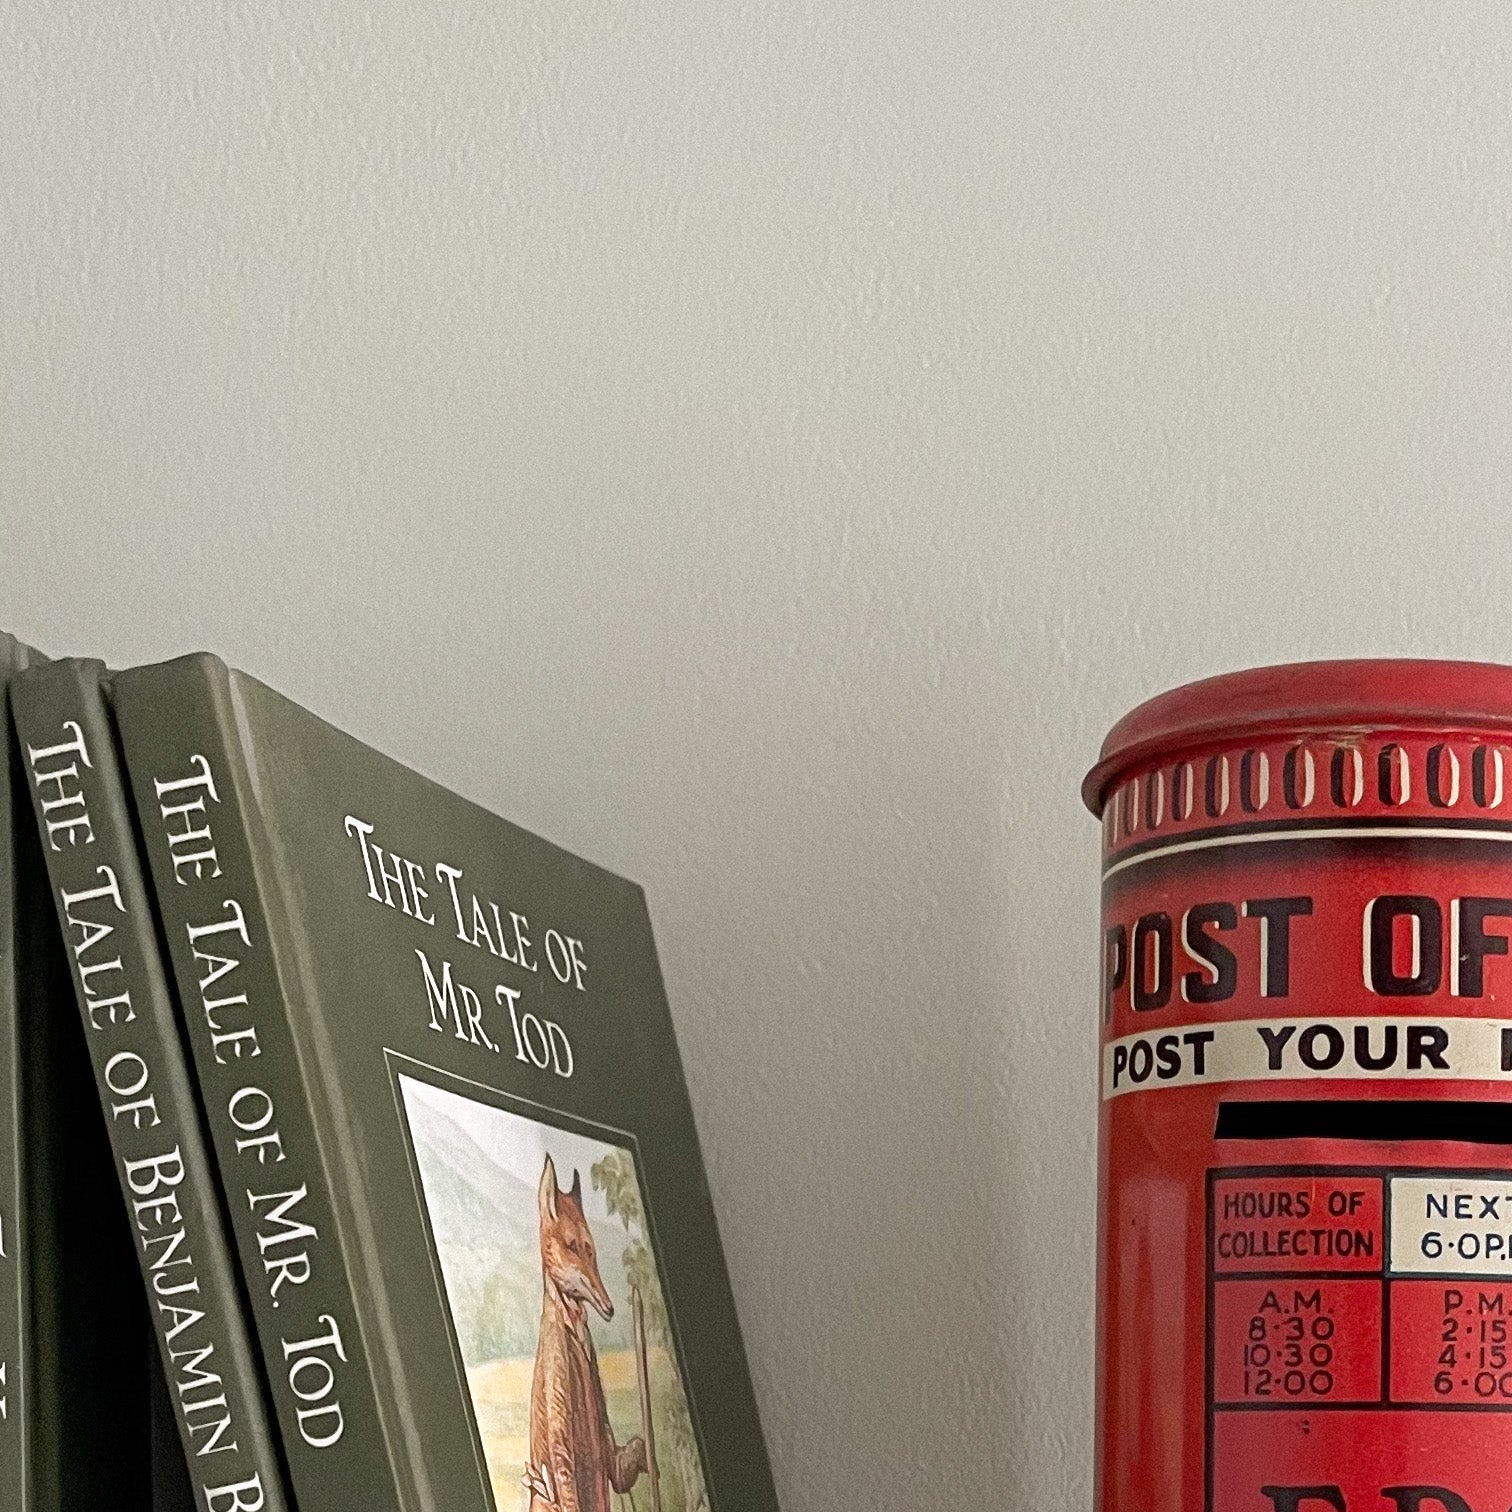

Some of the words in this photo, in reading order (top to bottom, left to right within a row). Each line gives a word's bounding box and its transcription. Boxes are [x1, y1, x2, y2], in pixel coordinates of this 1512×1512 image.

[27, 720, 95, 852] THE
[153, 754, 223, 886] THE
[61, 865, 137, 1031] TALE
[344, 814, 435, 926] THE
[435, 862, 538, 972] TALE
[544, 928, 588, 992] OF
[1103, 896, 1313, 1026] POST
[186, 899, 262, 1065] TALE
[414, 948, 500, 1053] MR.
[495, 984, 574, 1078] TOD
[104, 1050, 162, 1130] OF
[1112, 1030, 1215, 1089] POST
[1257, 1023, 1451, 1073] YOUR
[228, 1086, 287, 1164] OF
[246, 1182, 319, 1309] MR.
[1217, 1228, 1375, 1259] COLLECTION
[1223, 1190, 1310, 1220] HOURS
[1327, 1190, 1366, 1217] OF
[123, 1144, 239, 1457] BENJAMIN
[281, 1314, 349, 1448] TOD
